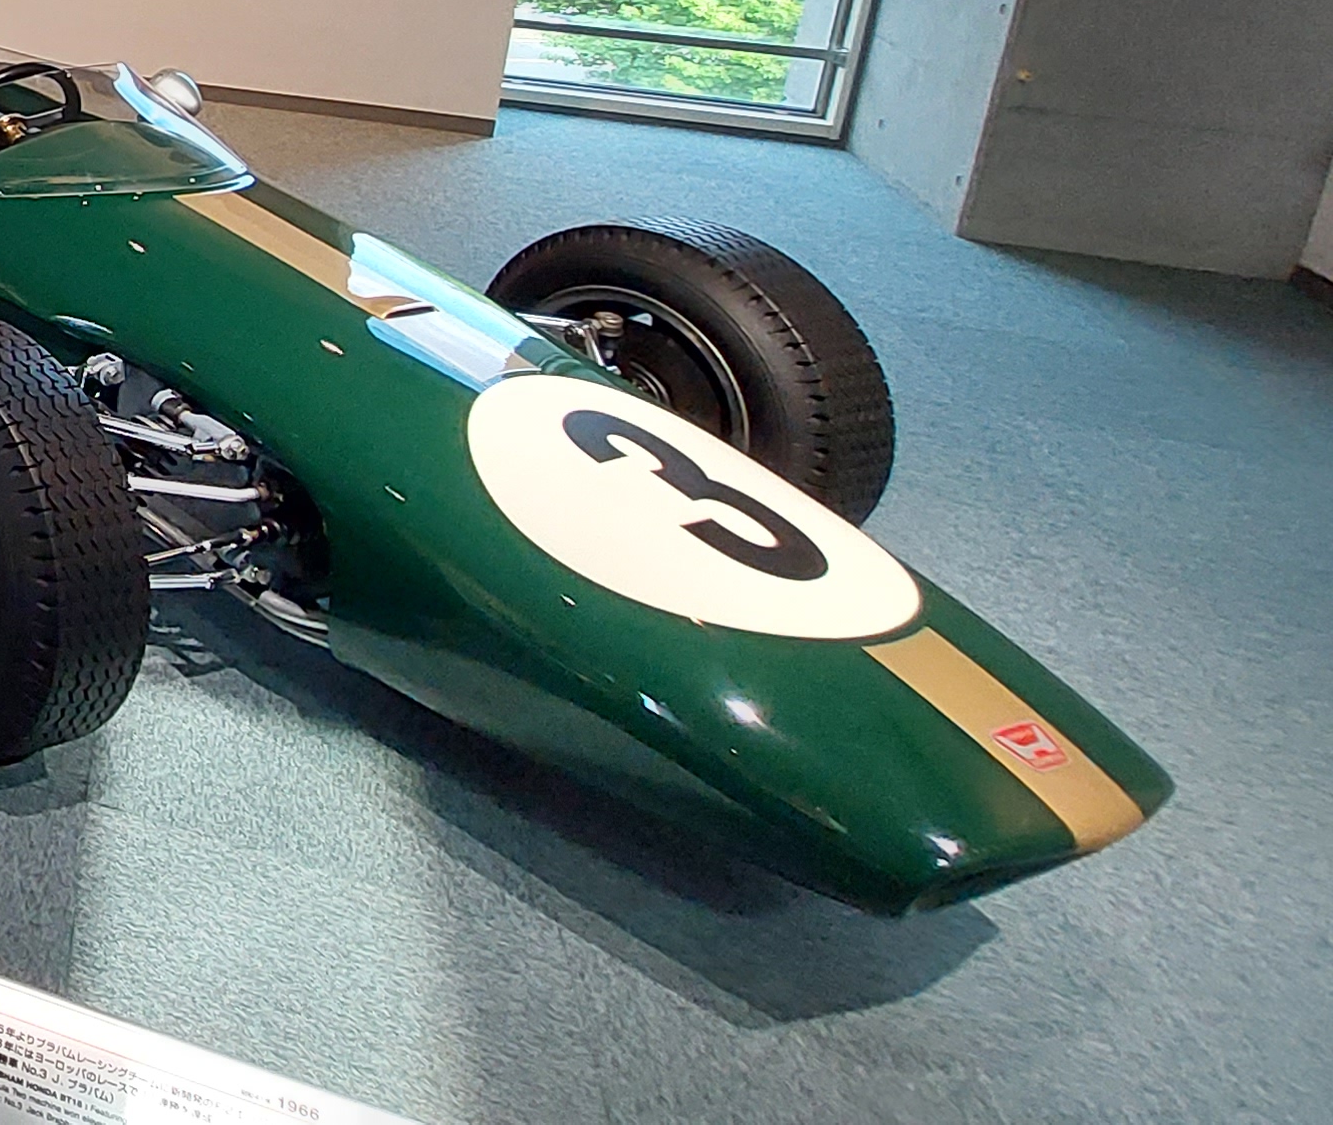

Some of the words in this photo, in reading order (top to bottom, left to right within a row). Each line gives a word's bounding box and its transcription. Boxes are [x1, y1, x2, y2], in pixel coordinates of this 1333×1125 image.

[562, 410, 828, 580] 3
[21, 1060, 48, 1080] No.3
[278, 1096, 320, 1122] 1966
